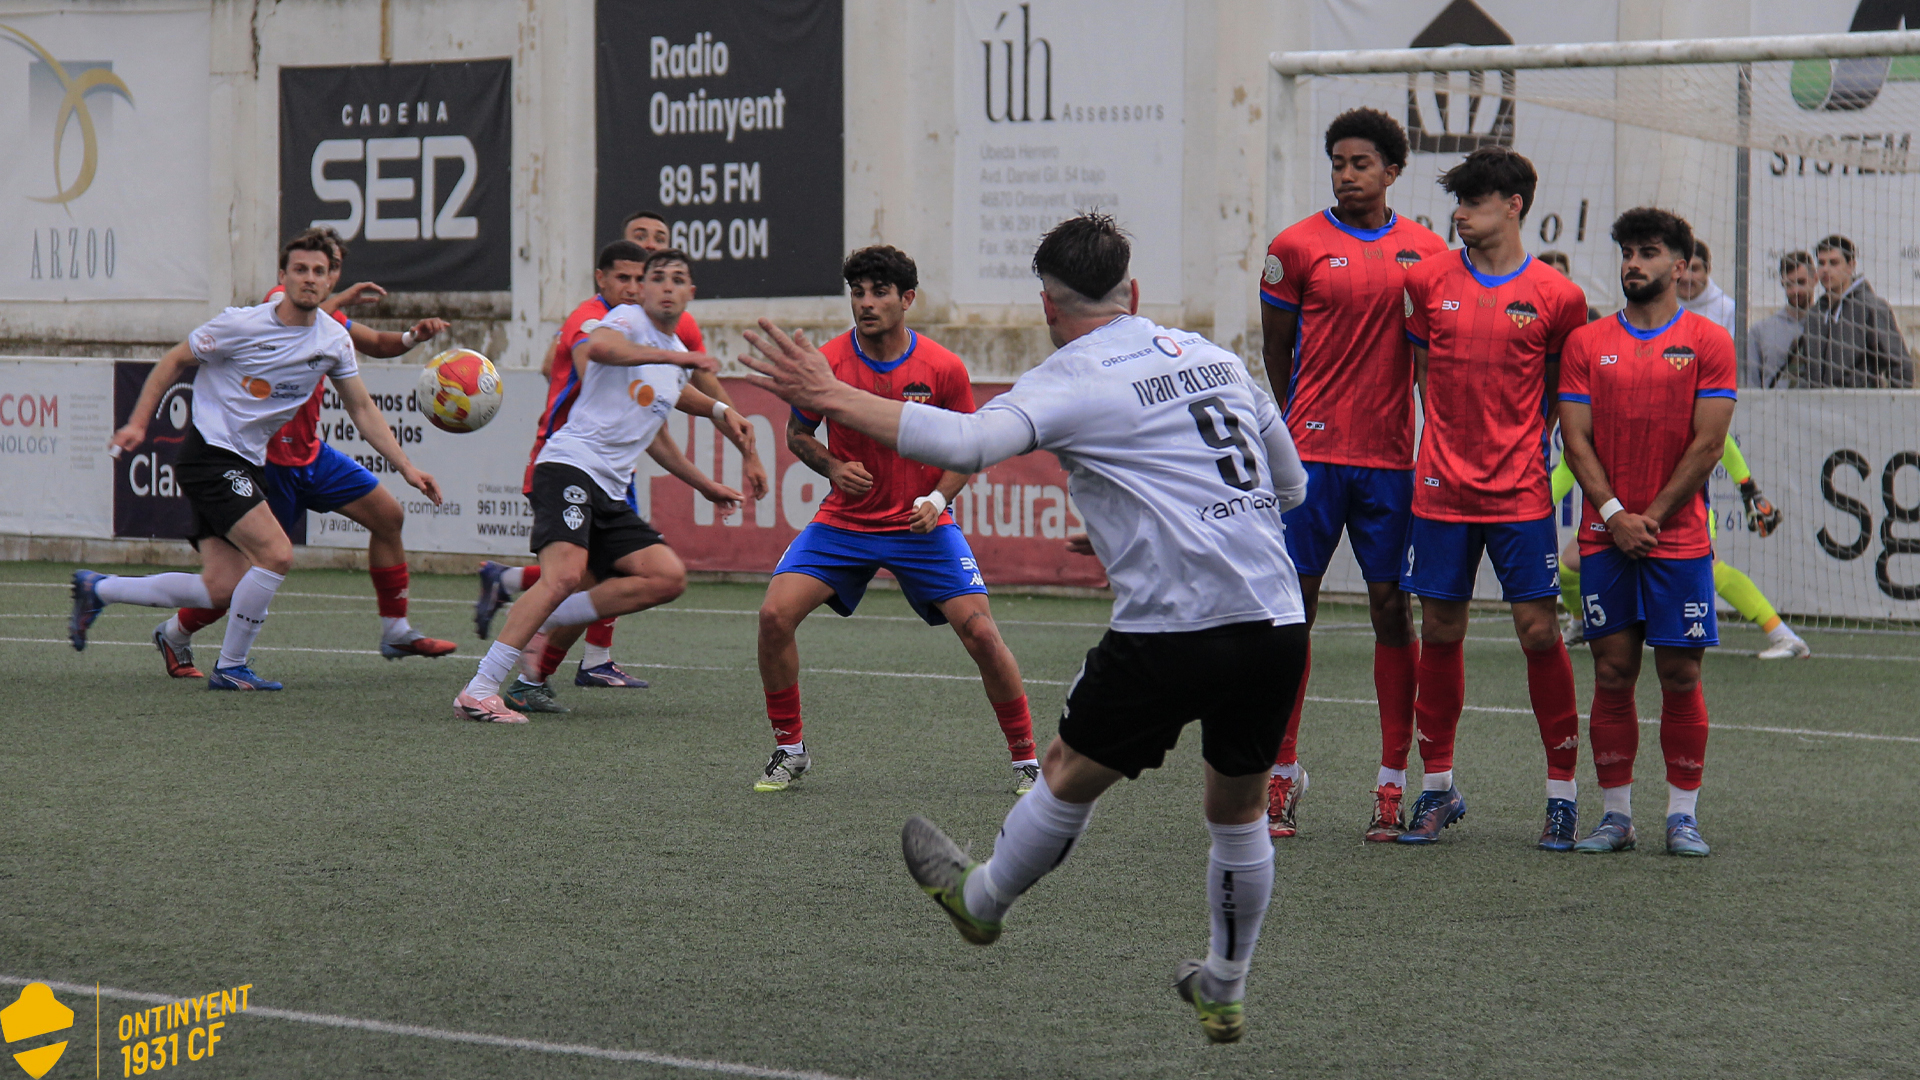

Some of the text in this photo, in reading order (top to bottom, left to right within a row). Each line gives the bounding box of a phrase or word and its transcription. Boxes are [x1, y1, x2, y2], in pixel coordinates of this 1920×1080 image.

[650, 31, 729, 79] Radio
[979, 2, 1165, 122] úh Assessors
[341, 101, 448, 126] CADENA
[650, 87, 786, 142] Ontinyent
[1770, 132, 1912, 176] SYSTEM
[310, 135, 478, 241] SER
[659, 161, 760, 207] 89.5 FM
[31, 228, 115, 280] ARZOO
[671, 217, 769, 261] 602 OM
[1101, 347, 1154, 368] ORDIBER
[0, 393, 58, 427] COM
[322, 388, 403, 412] Cumos
[321, 417, 355, 444] y de
[1188, 395, 1260, 492] 9
[408, 500, 461, 518] completa
[477, 499, 496, 515] 961
[499, 500, 519, 517] 911
[953, 472, 1087, 539] nturas
[476, 521, 533, 537] www.clar
